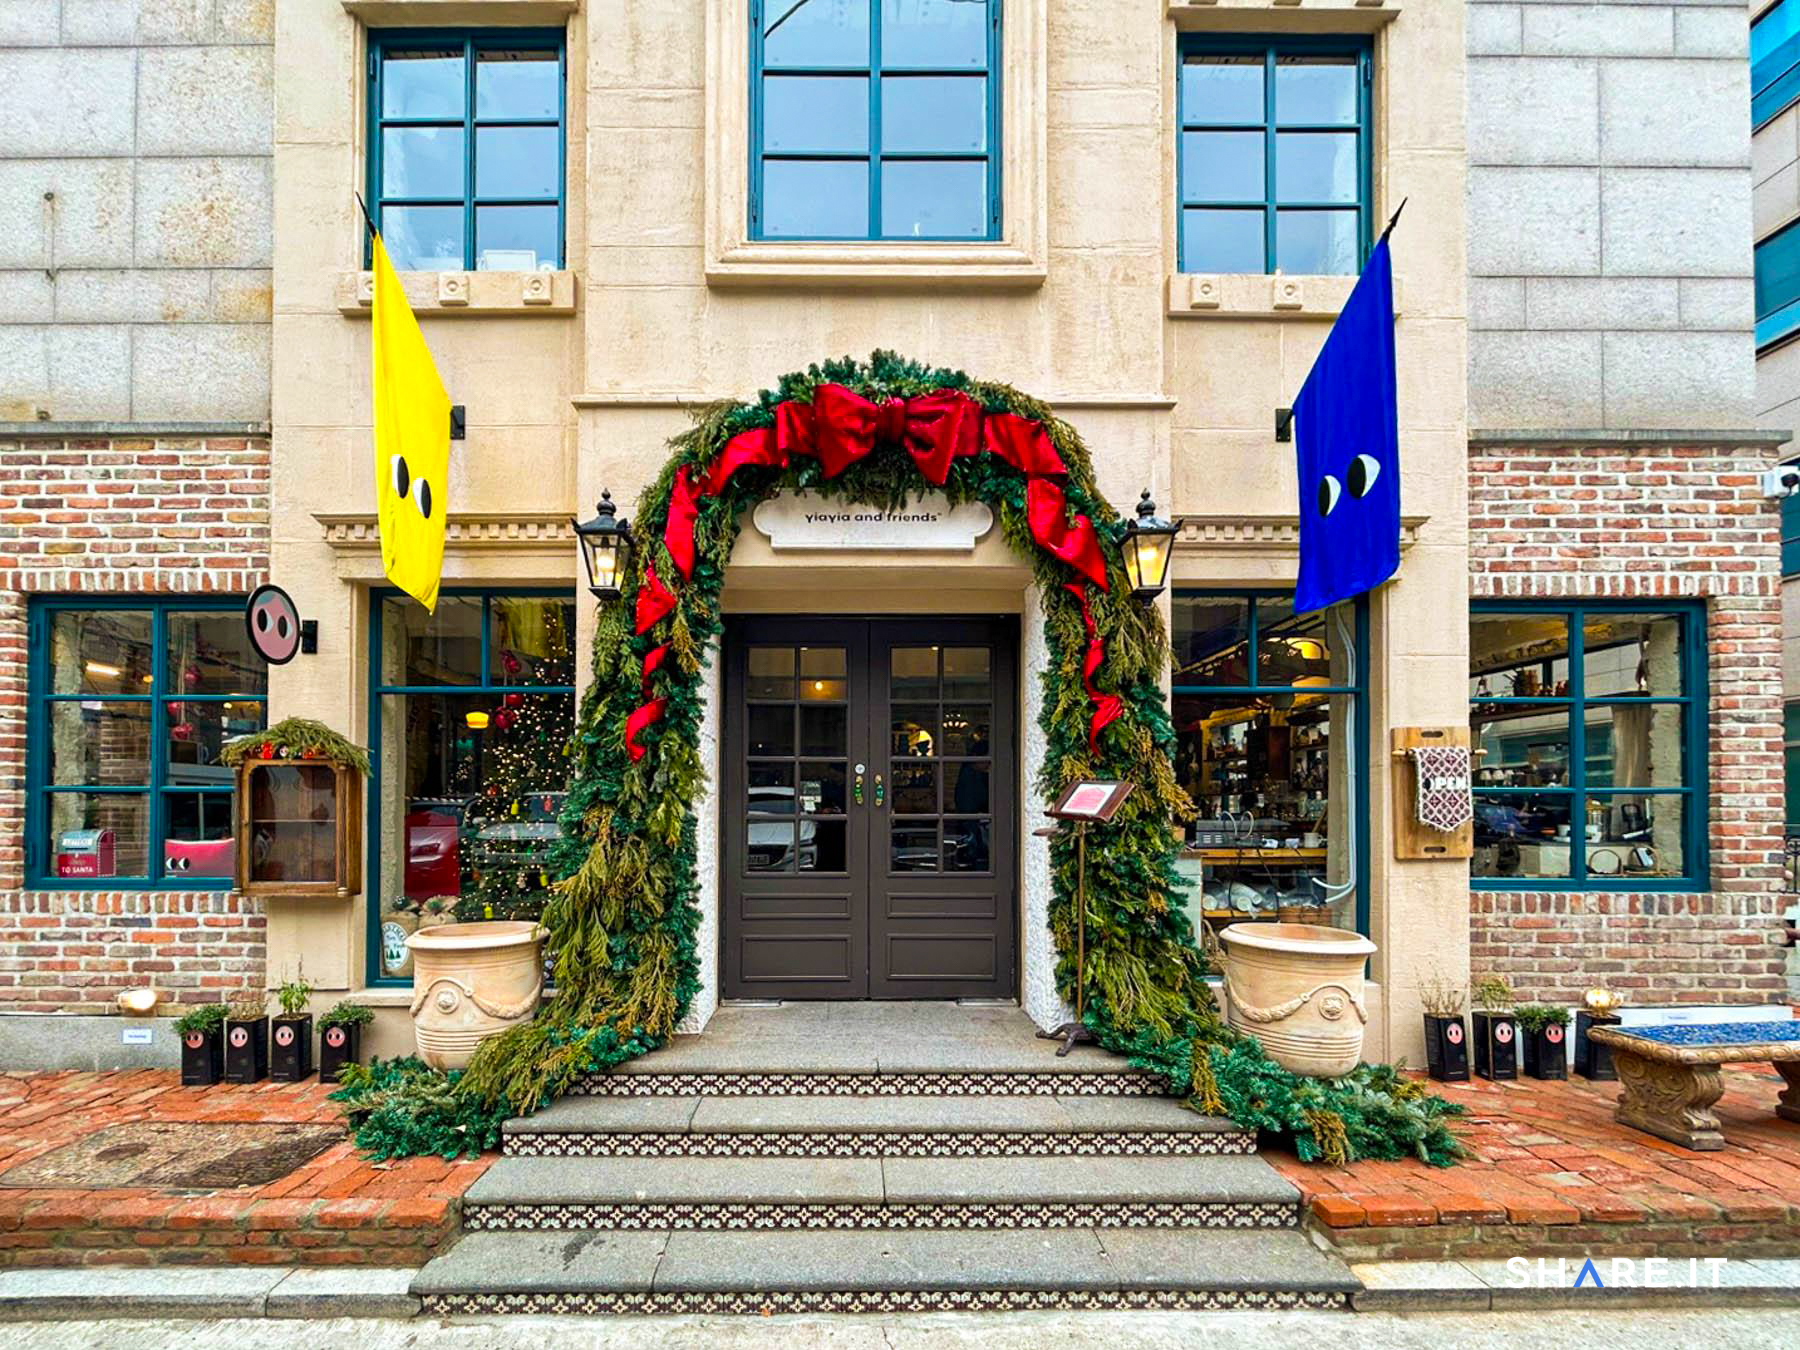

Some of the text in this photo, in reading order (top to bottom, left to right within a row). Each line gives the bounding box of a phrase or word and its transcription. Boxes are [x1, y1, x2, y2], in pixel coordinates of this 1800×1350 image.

[805, 512, 937, 523] yiayia and friends
